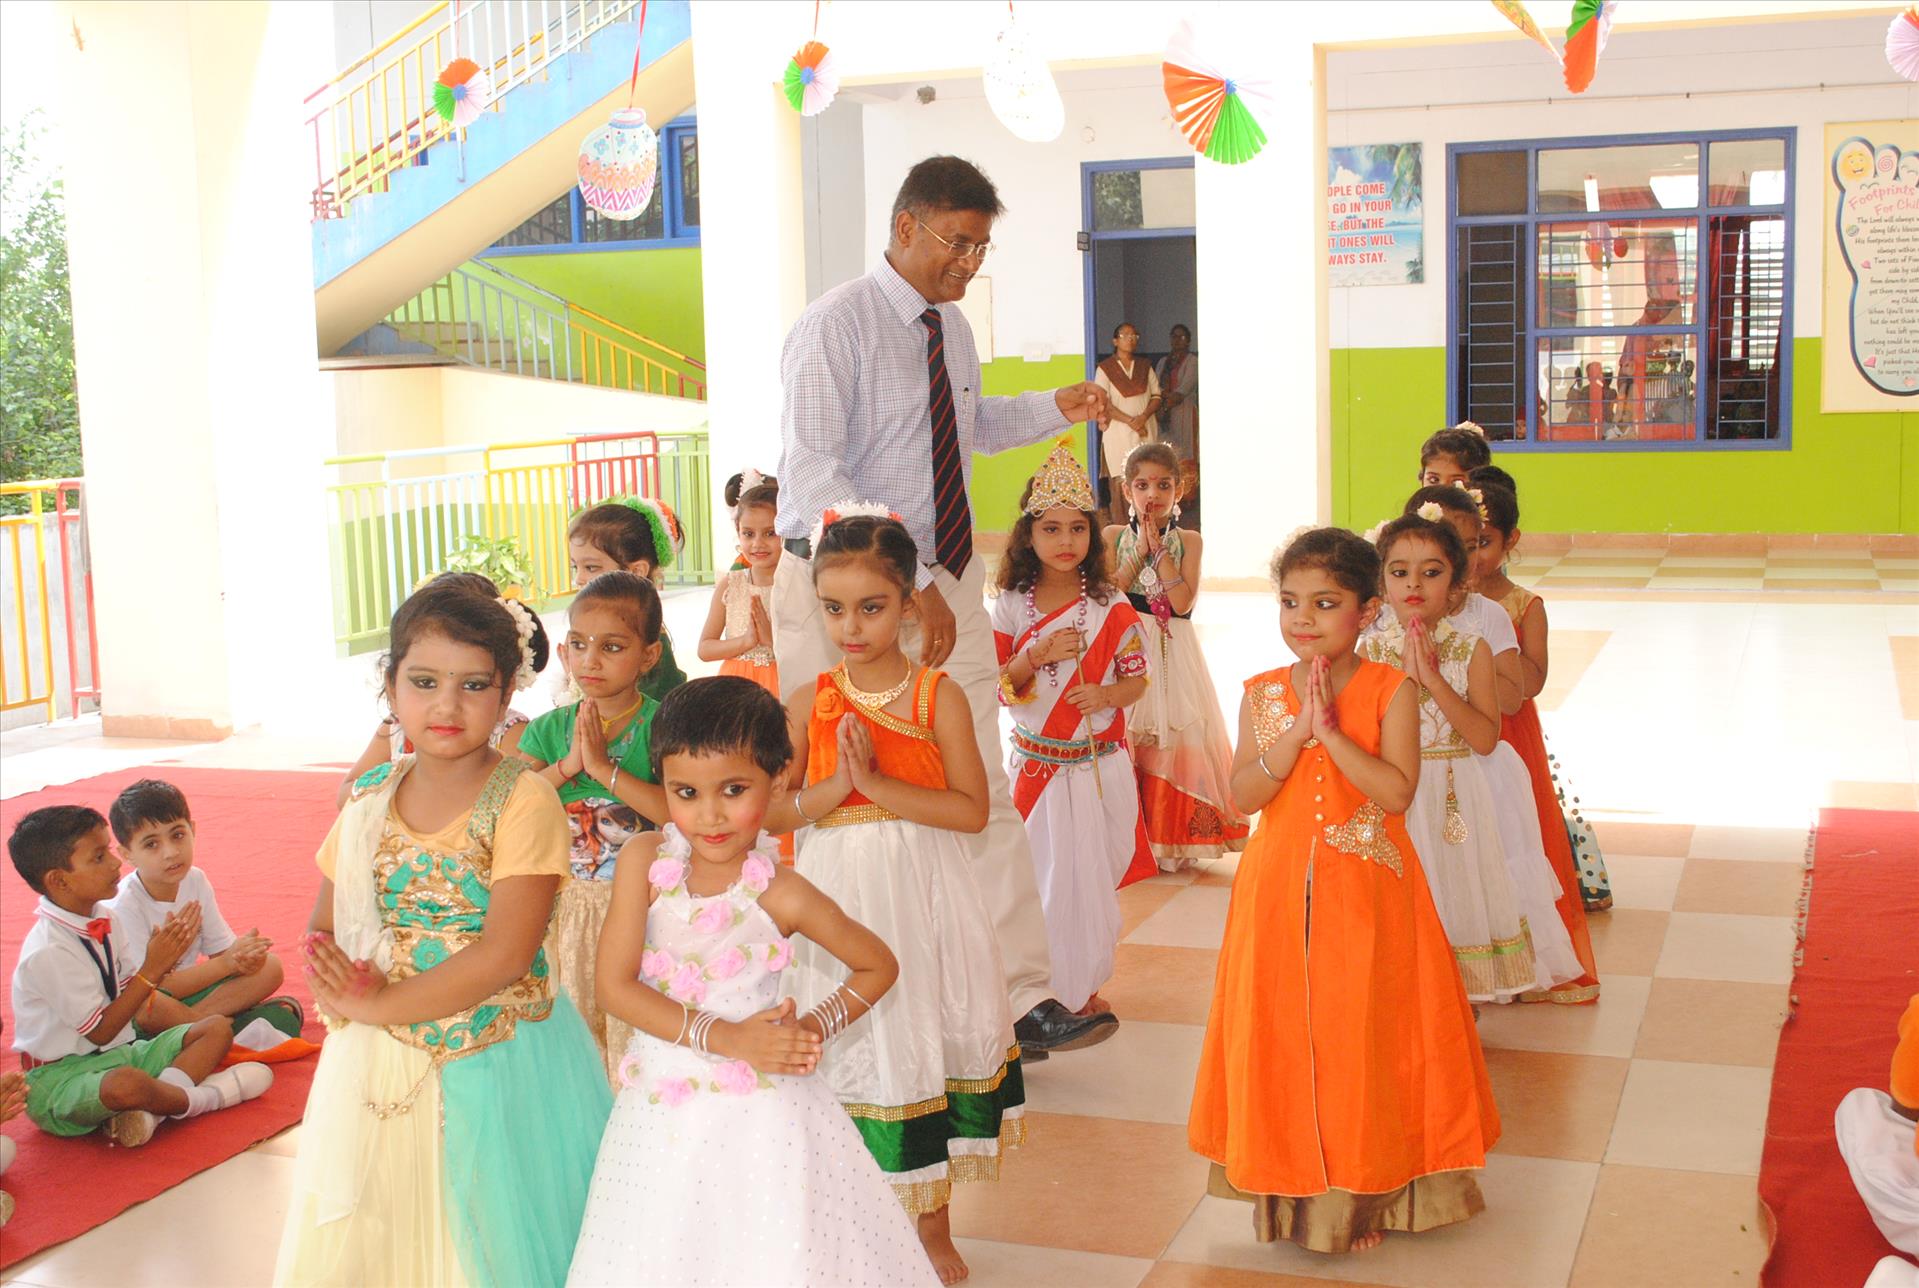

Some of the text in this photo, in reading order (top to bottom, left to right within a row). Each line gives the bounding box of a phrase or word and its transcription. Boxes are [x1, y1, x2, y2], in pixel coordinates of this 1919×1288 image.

[1355, 183, 1385, 195] COME
[1848, 185, 1915, 210] Footprints
[1333, 200, 1392, 214] GO IN YOUR
[1874, 203, 1894, 216] For
[1344, 218, 1362, 230] BUT
[1366, 218, 1384, 229] THE
[1857, 216, 1868, 224] The
[1340, 236, 1367, 248] ONES
[1370, 235, 1394, 245] WILL
[1359, 252, 1387, 264] STAY.
